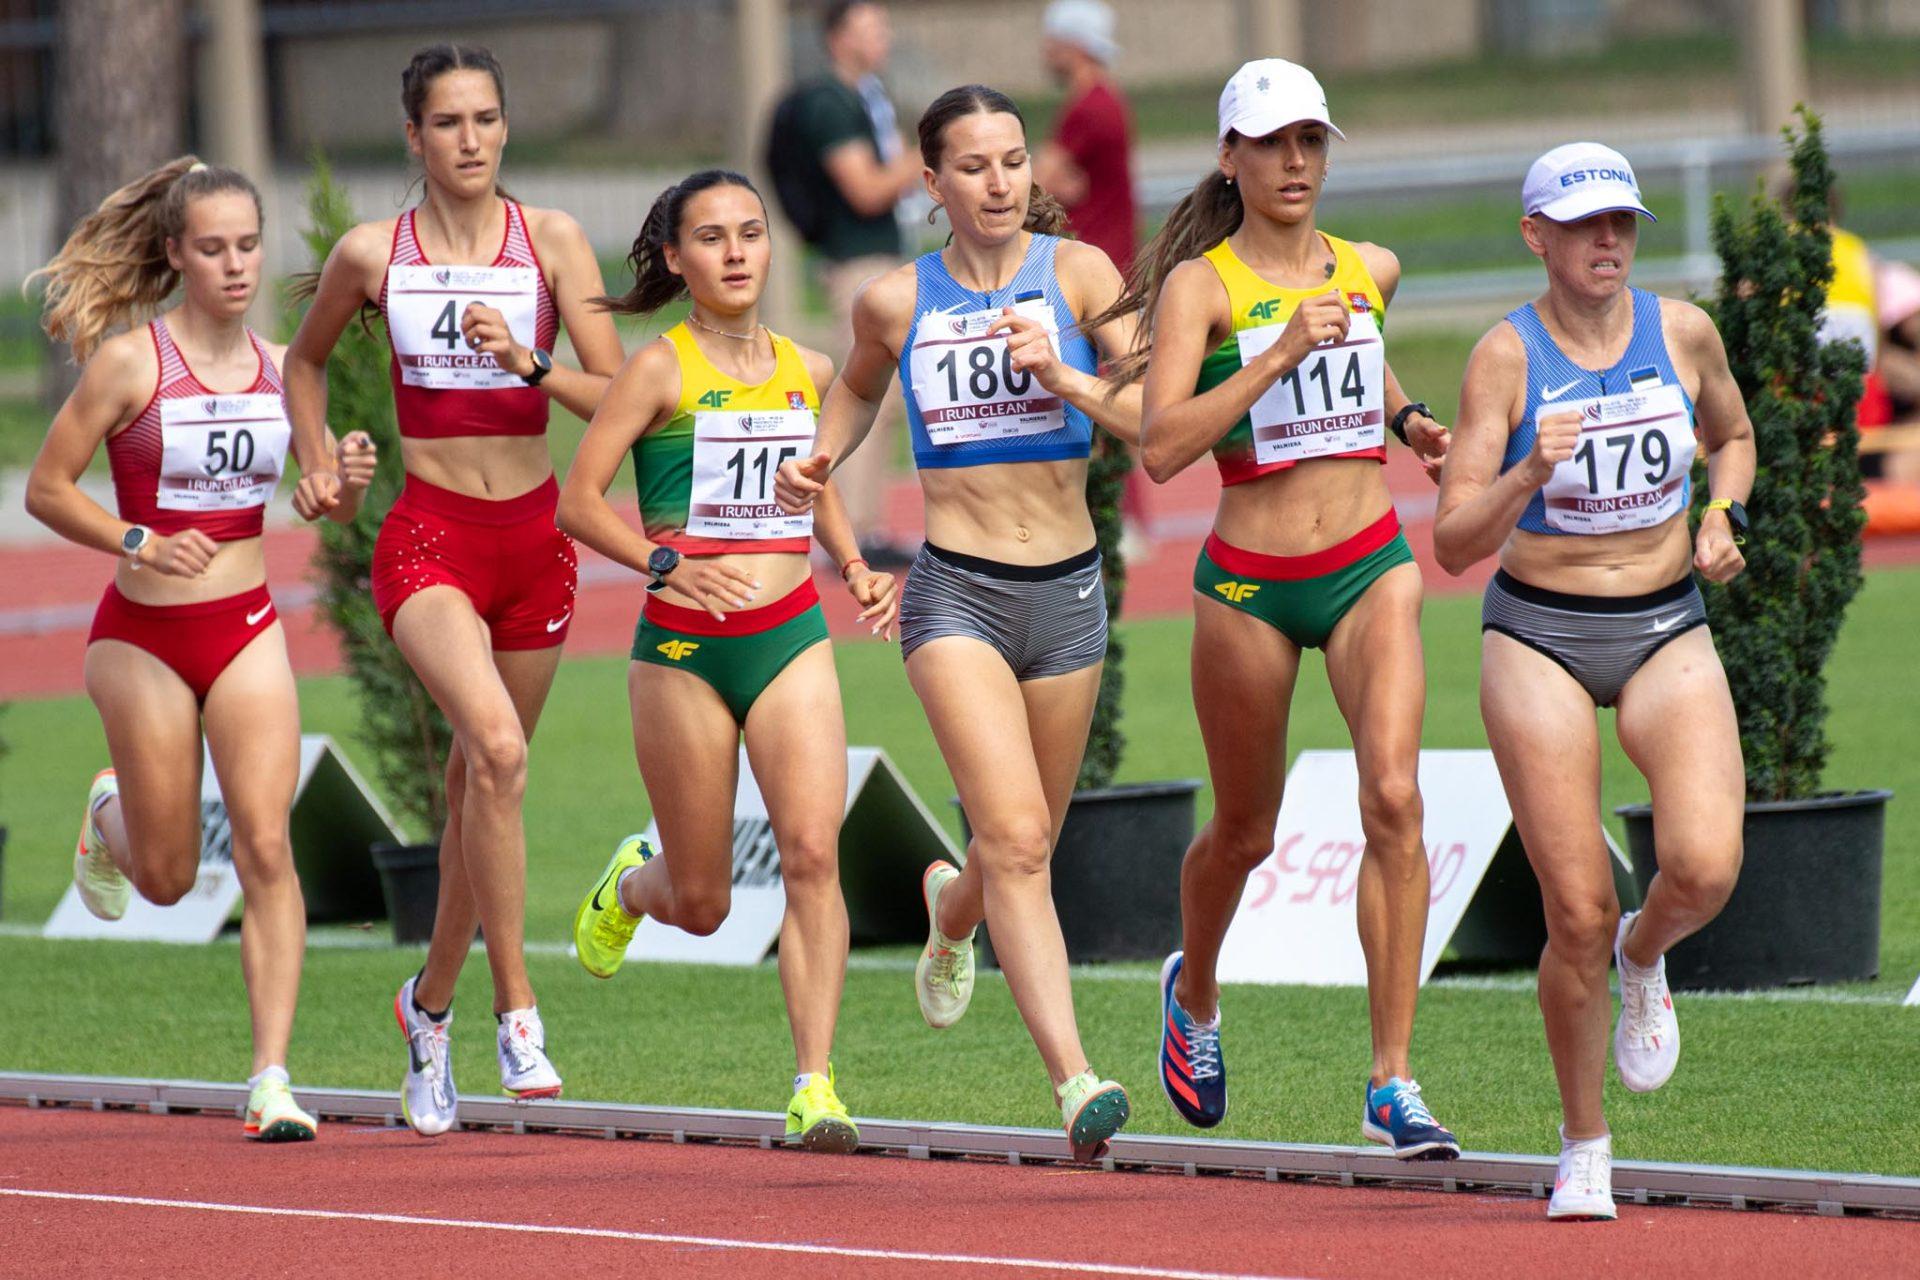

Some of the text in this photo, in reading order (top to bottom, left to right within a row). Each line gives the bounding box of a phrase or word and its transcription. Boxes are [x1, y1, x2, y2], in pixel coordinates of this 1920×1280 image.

[1248, 298, 1281, 319] 4F
[417, 356, 422, 367] I
[424, 356, 452, 368] RUN
[936, 346, 1031, 402] 180
[1281, 351, 1365, 416] 114
[697, 389, 733, 408] 4F
[939, 410, 944, 422] I
[946, 407, 976, 421] RUN
[1286, 425, 1291, 437] I
[1294, 422, 1322, 437] RUN
[204, 428, 255, 477] 50
[1574, 428, 1672, 495] 179
[187, 479, 192, 490] I
[194, 479, 221, 492] RUN
[223, 475, 253, 491] CLEAN
[719, 505, 785, 518] I RUN CLEA
[1578, 500, 1582, 511] I
[1585, 499, 1616, 512] RUN
[1214, 581, 1261, 603] 4F
[656, 640, 700, 661] 4F
